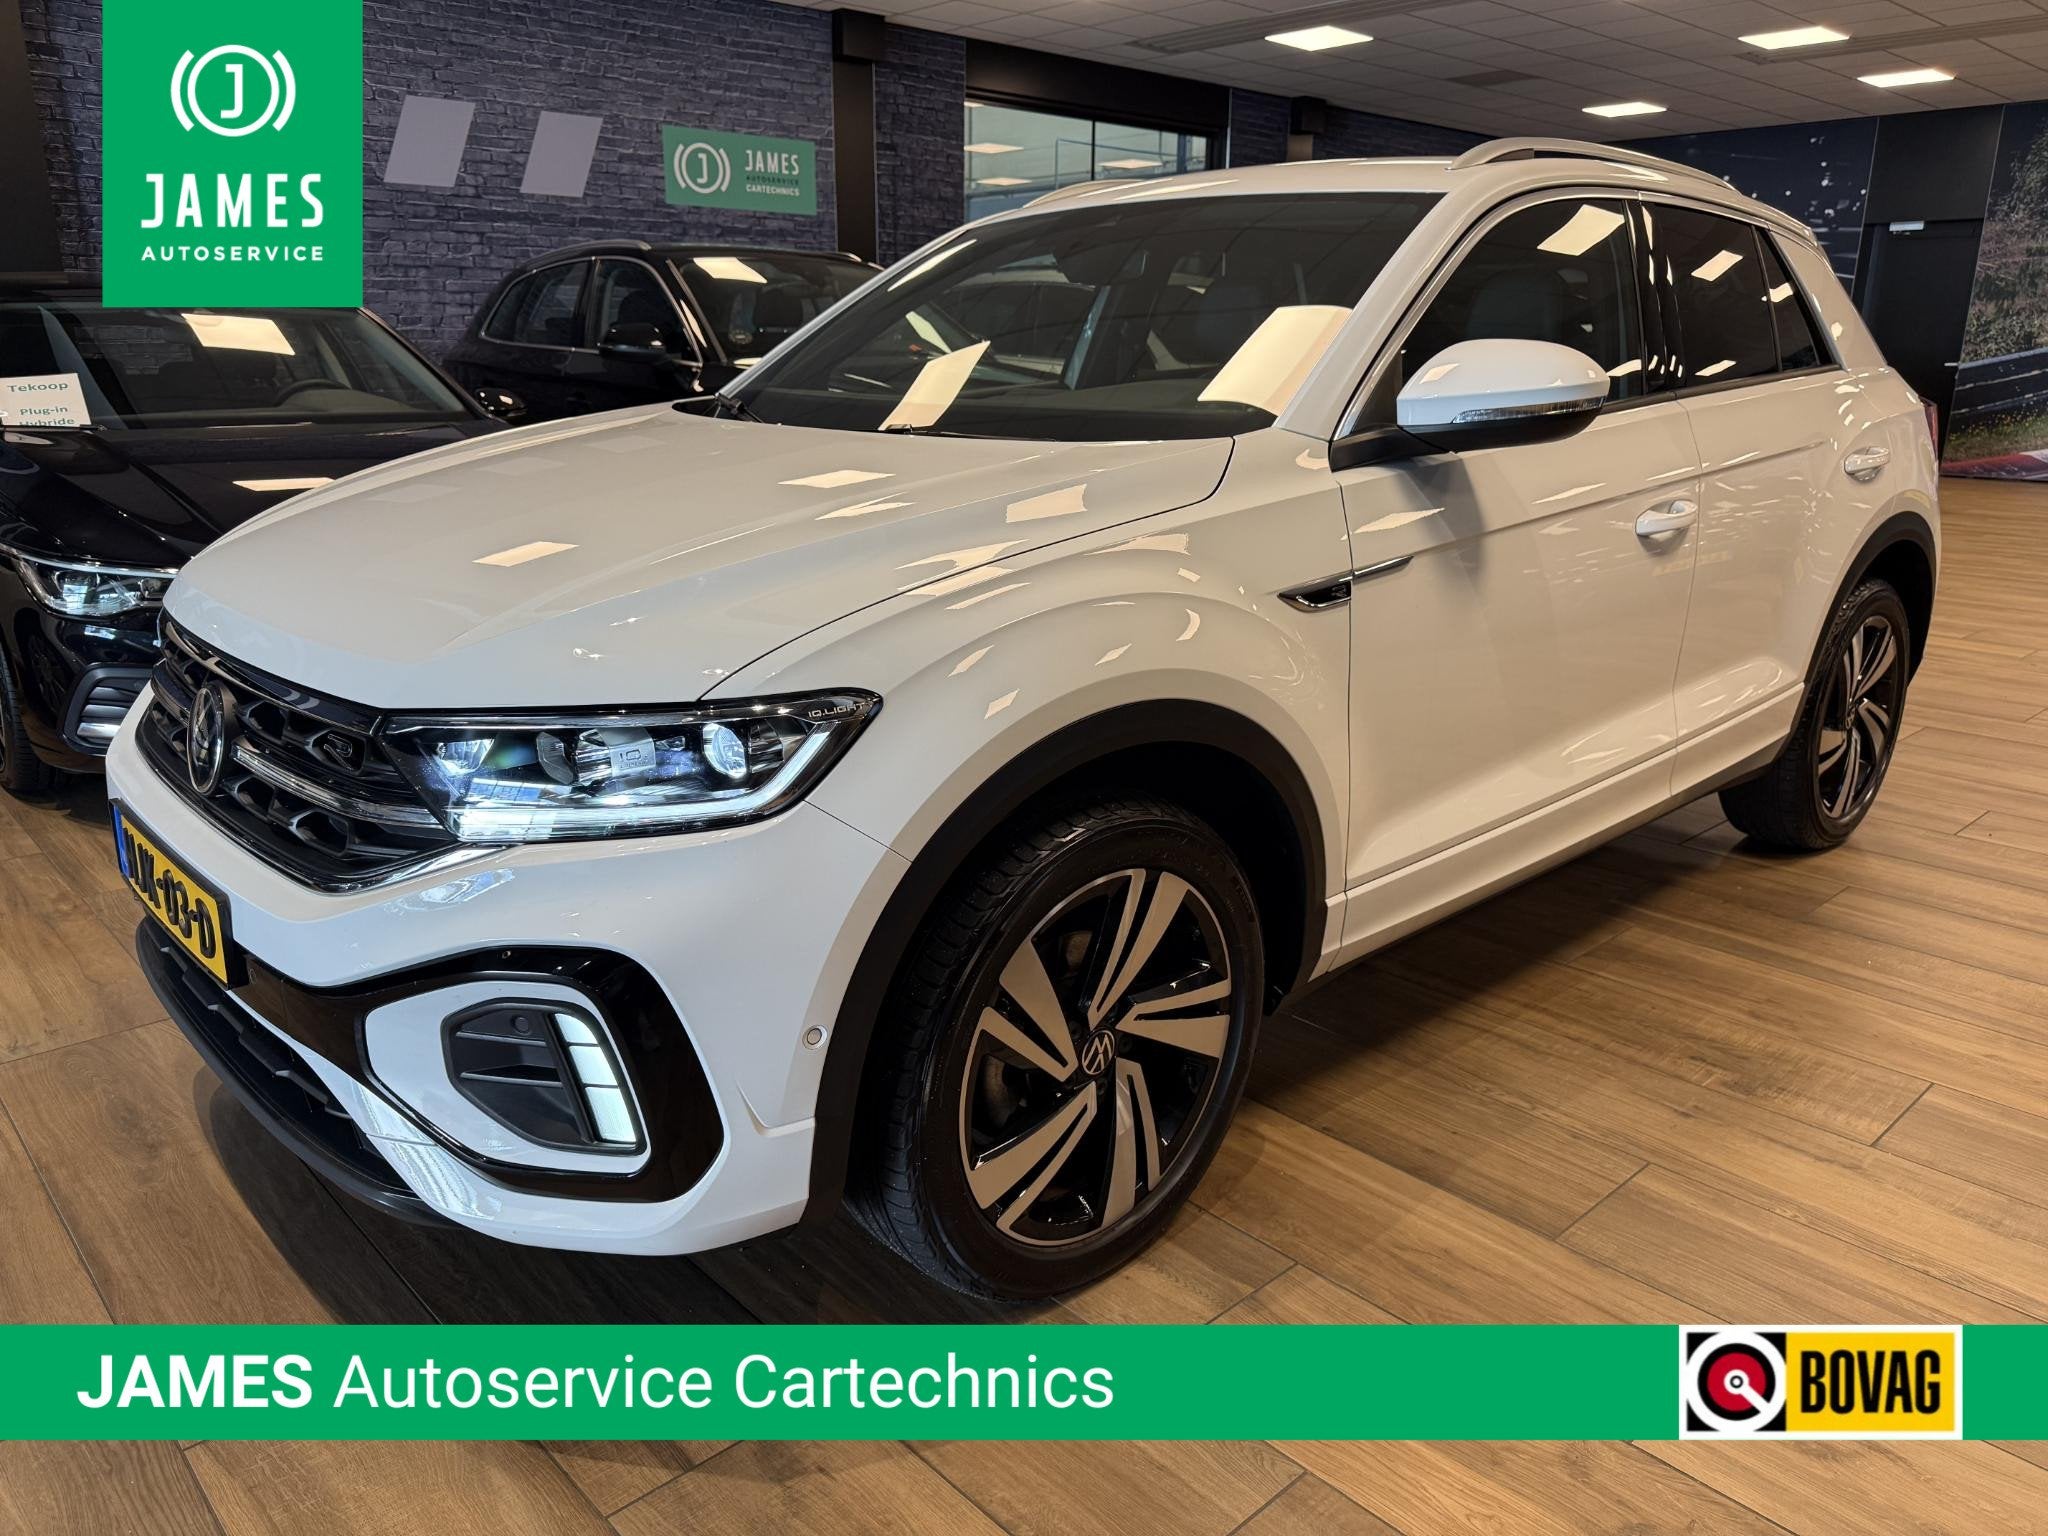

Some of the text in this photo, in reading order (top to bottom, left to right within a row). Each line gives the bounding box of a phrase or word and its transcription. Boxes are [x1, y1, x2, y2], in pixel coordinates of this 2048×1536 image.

[745, 150, 800, 175] JAMES
[746, 174, 800, 186] AUTOSERVICE
[745, 184, 801, 197] CARTECHNICS
[7, 382, 69, 393] Tekoop
[20, 405, 69, 416] Plug-in
[807, 702, 866, 719] IQ.LIGHT
